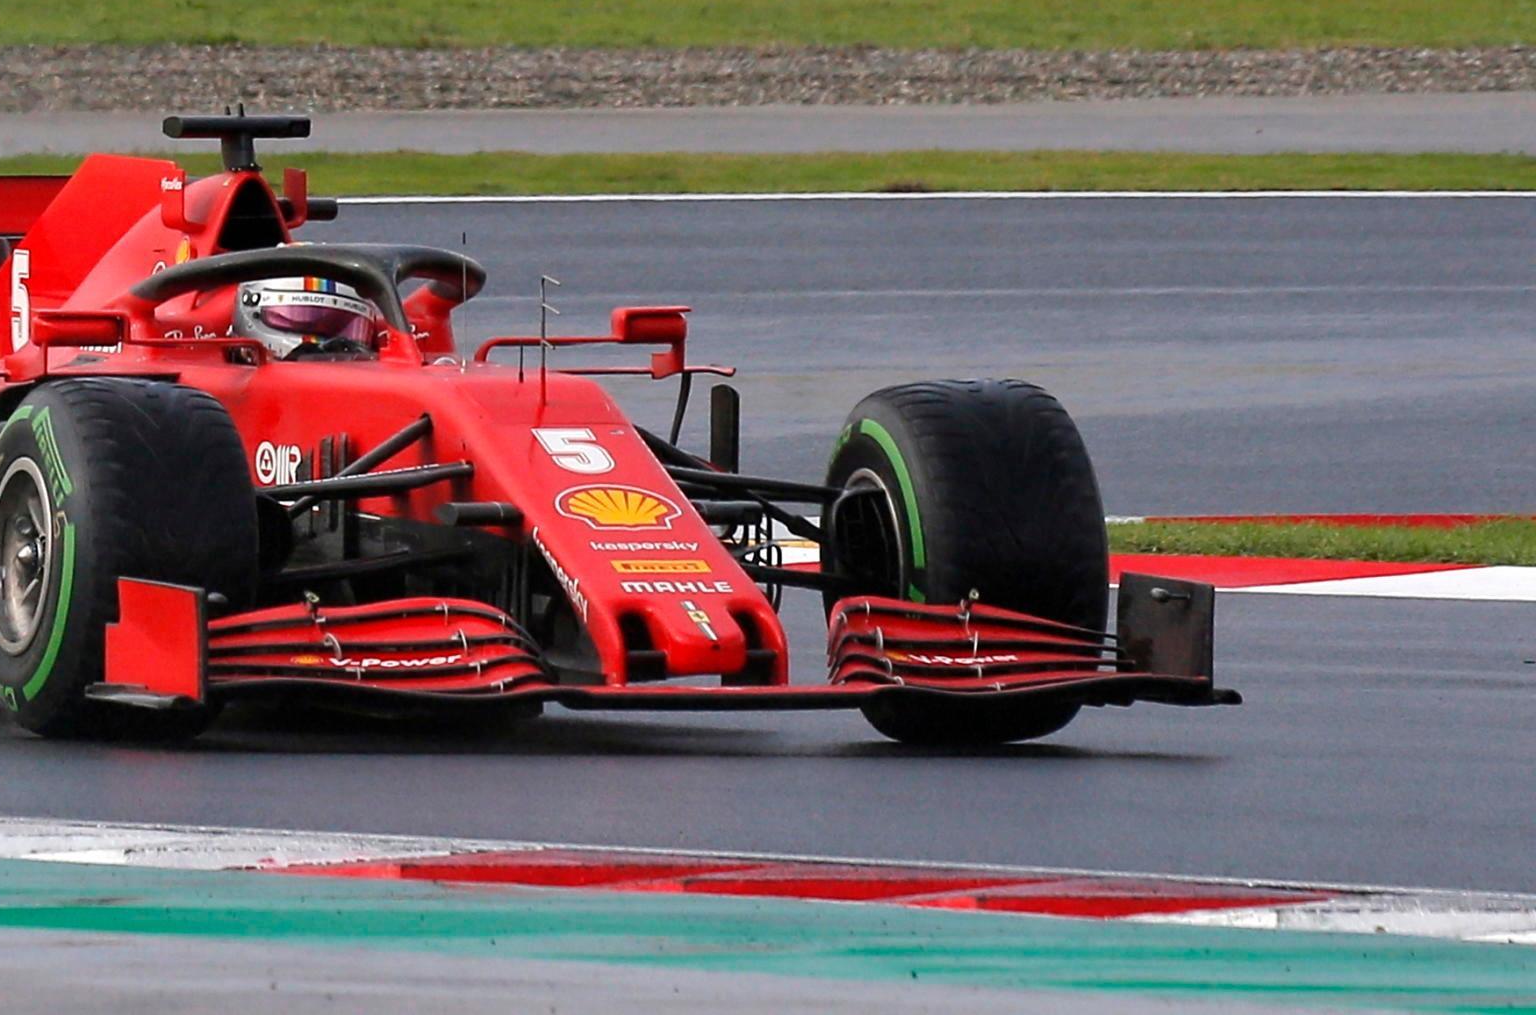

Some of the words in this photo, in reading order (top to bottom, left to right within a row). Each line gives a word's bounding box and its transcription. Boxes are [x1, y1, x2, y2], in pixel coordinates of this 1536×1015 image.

[11, 249, 30, 353] 5
[530, 428, 616, 474] 5
[589, 540, 700, 552] kaspersky
[620, 580, 734, 594] MAHLE
[329, 654, 462, 668] V-Power
